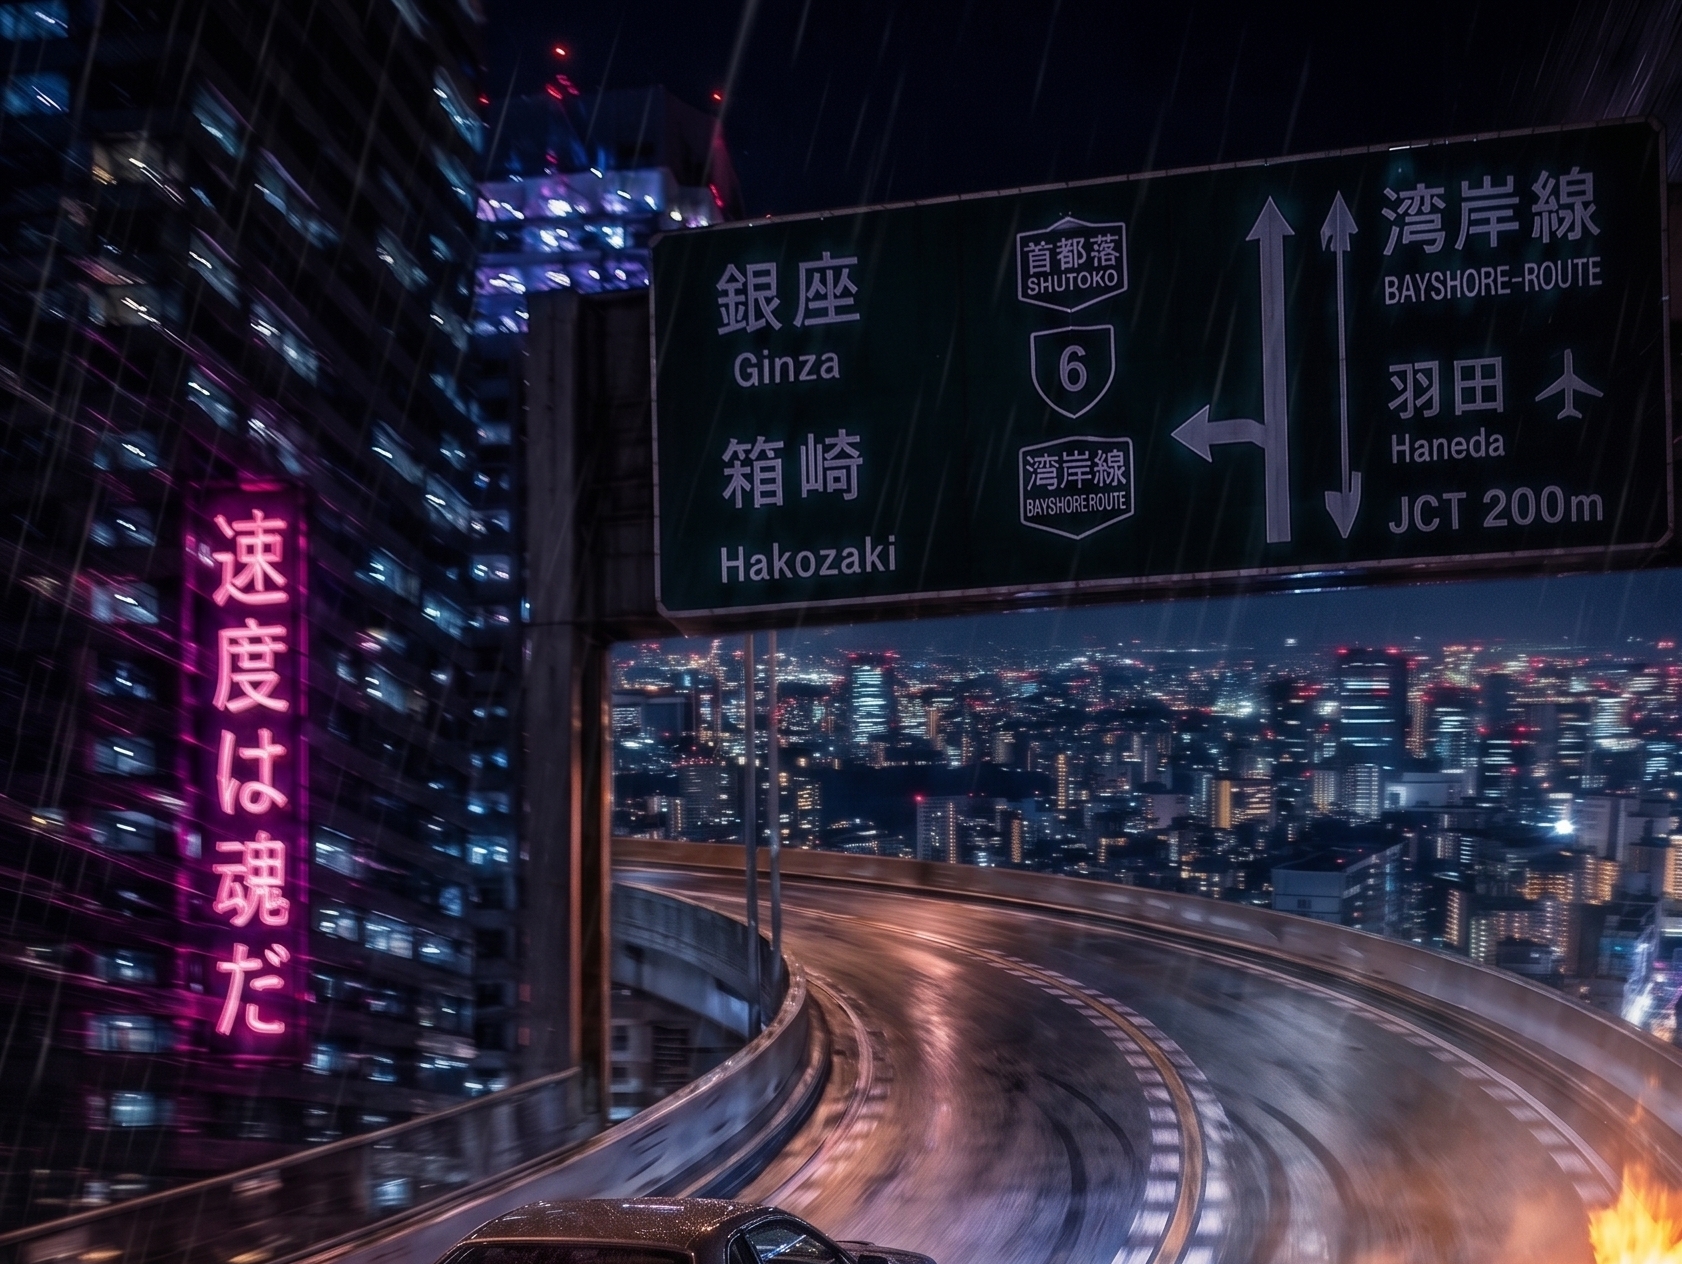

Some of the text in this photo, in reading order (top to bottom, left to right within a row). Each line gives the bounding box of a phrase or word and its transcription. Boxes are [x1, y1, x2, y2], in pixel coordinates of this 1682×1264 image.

[1381, 166, 1601, 256] 湾岸線
[716, 251, 861, 336] 銀座
[1027, 269, 1118, 295] SHUTOKO
[1383, 256, 1603, 305] BAYSHORE-ROUTE
[734, 349, 840, 387] Ginza
[1059, 345, 1088, 392] 6
[1387, 356, 1504, 420] 羽田
[721, 428, 864, 509] 箱崎
[1026, 448, 1127, 491] 湾岸線
[1391, 427, 1506, 464] Haneda
[1026, 491, 1127, 517] BAYSHORE ROUTE
[1388, 485, 1603, 534] JCT 200m
[720, 535, 896, 584] Hakozaki
[212, 508, 291, 1037] 速度は魂だ
